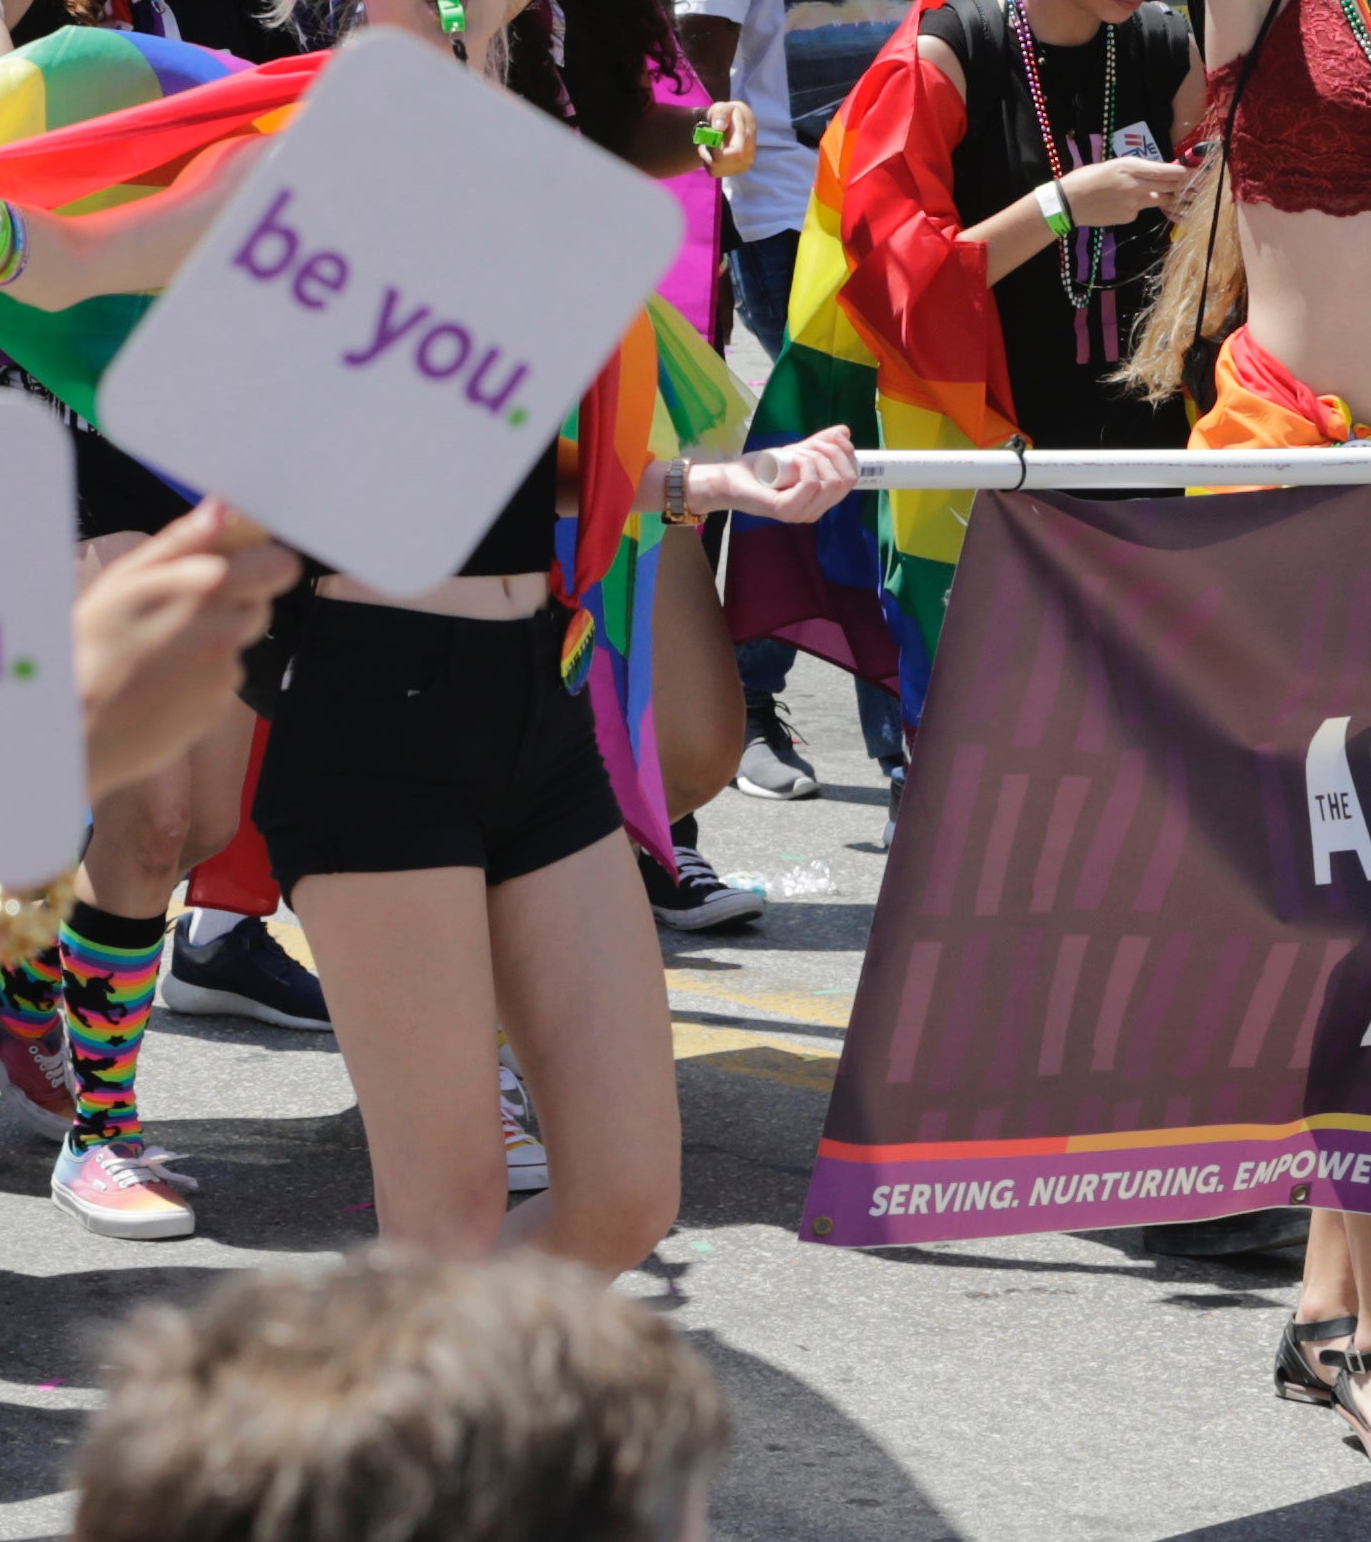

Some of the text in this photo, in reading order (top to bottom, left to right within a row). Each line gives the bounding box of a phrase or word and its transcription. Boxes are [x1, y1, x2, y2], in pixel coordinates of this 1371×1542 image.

[229, 187, 532, 427] be you.
[1314, 792, 1352, 821] THE
[869, 1178, 1020, 1218] SERVING.
[1029, 1164, 1226, 1208] NURTURING.
